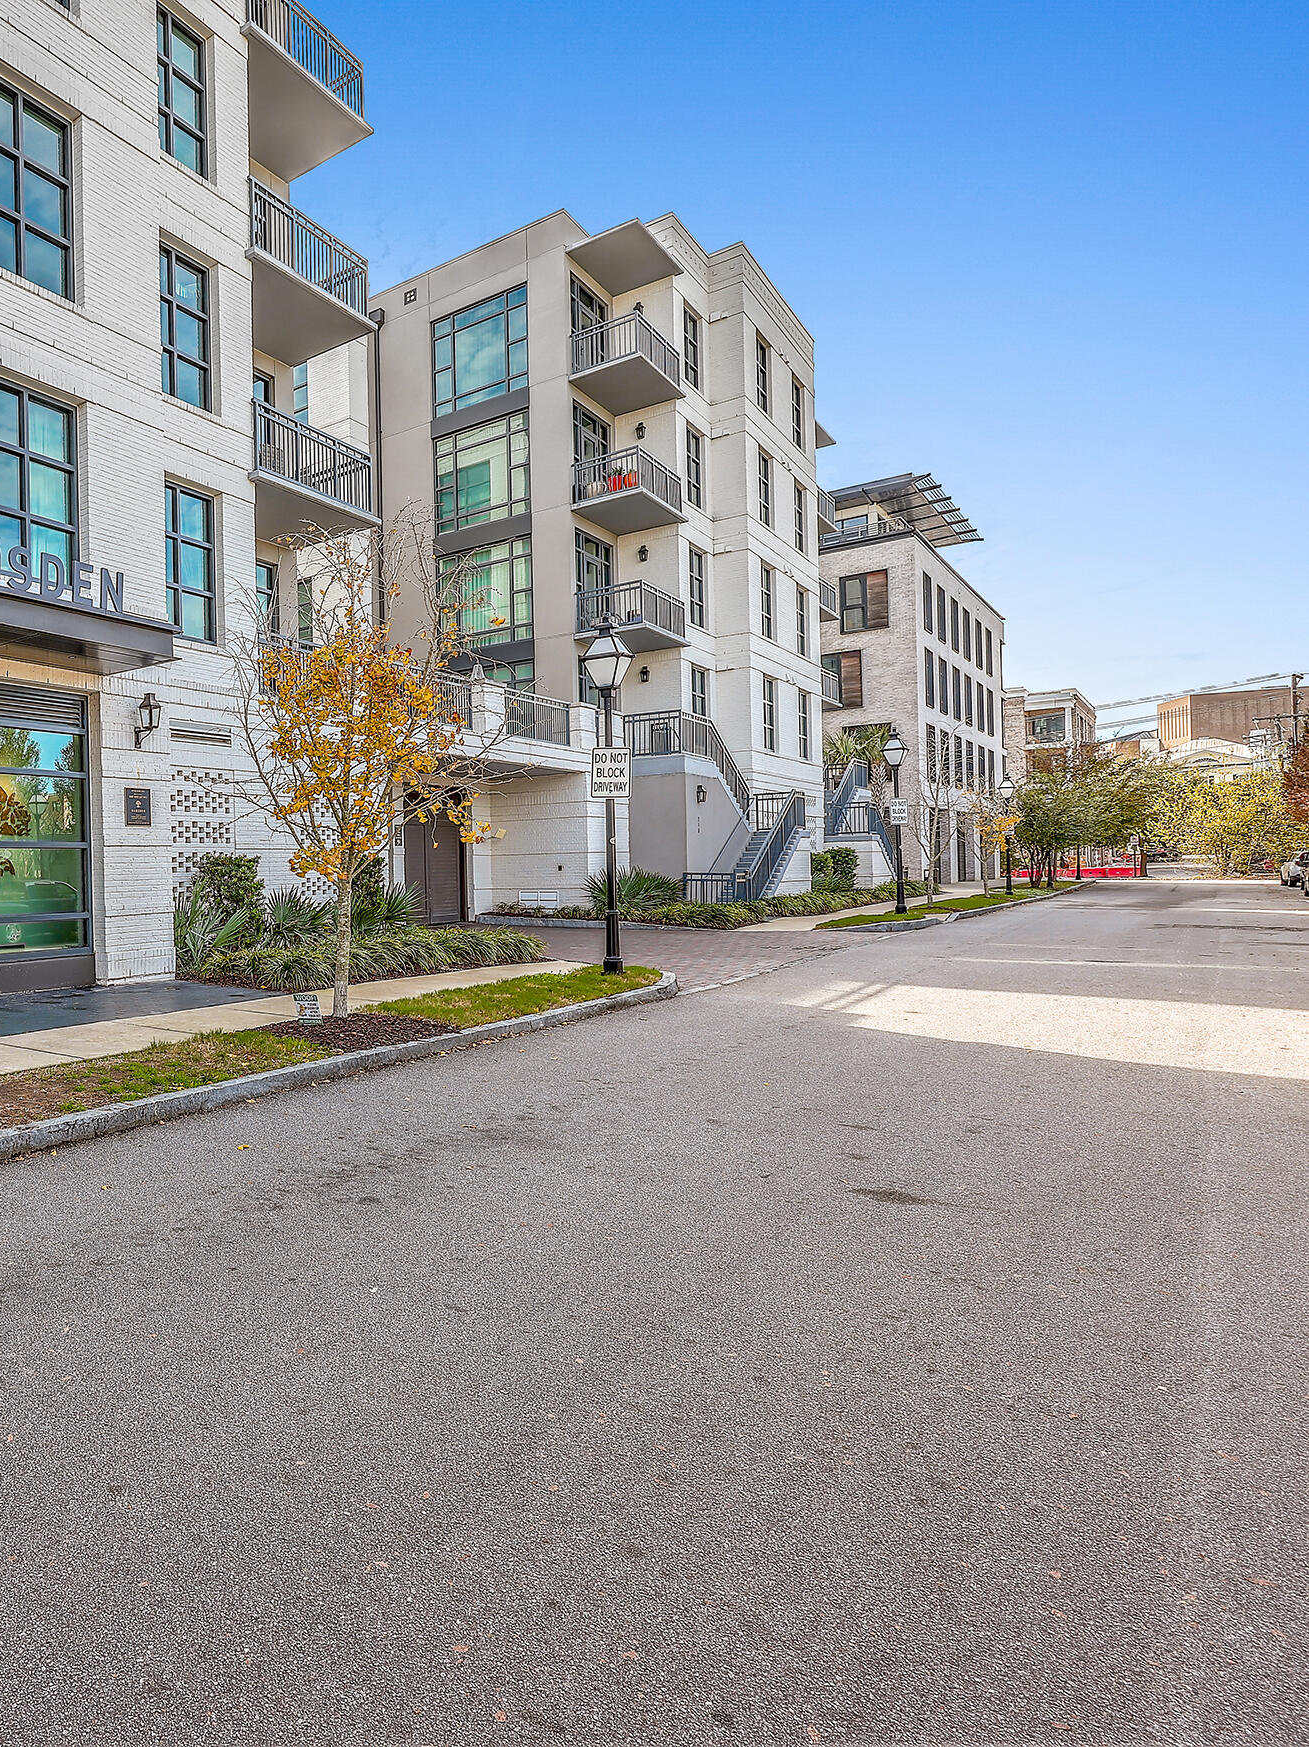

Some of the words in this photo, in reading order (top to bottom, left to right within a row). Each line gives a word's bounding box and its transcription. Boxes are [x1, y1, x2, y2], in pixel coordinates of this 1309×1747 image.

[594, 752, 608, 764] DO
[610, 752, 628, 764] NOT
[596, 767, 626, 778] BLOCK
[593, 781, 628, 793] DRIVEWAY
